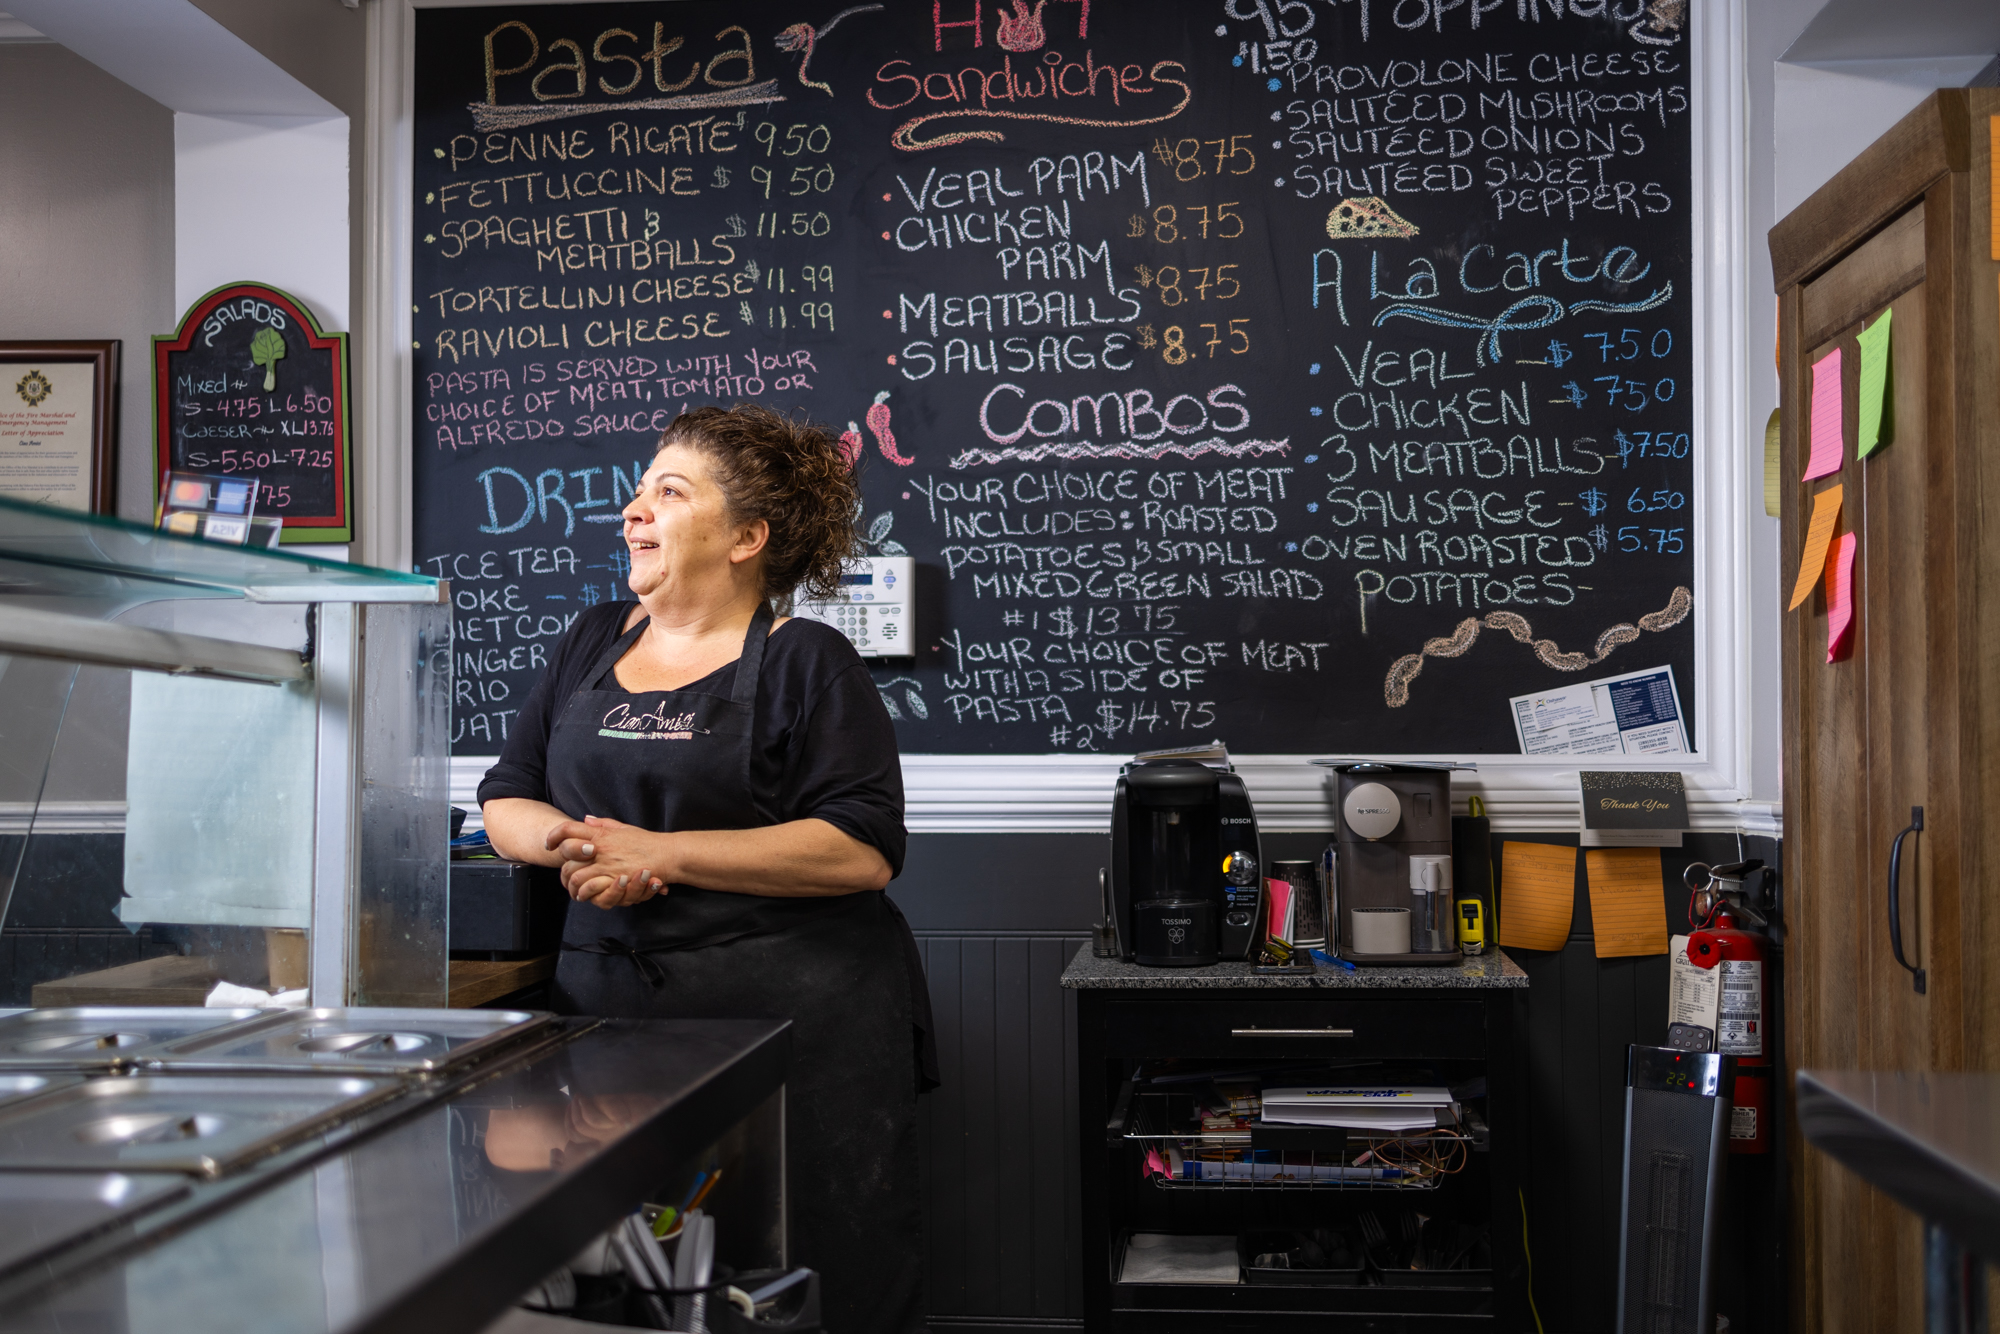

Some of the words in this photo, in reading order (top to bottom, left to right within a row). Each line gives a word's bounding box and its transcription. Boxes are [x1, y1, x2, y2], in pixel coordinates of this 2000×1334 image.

[484, 19, 756, 105] Pasta
[866, 49, 1191, 110] Sandwiches
[1286, 53, 1518, 94] PROVOLONE
[1528, 49, 1680, 83] CHEESE
[1480, 85, 1688, 127] MUSHROOMS
[451, 130, 594, 171] PENNE
[609, 115, 738, 158] RIGATE
[1481, 122, 1646, 157] ONIONS
[440, 167, 701, 213] FETTUCCINE
[897, 167, 1023, 213] VEAL
[1028, 151, 1150, 208] PARM
[1152, 135, 1256, 182] $8.75
[1484, 152, 1614, 188] SWEET
[1493, 182, 1672, 221] PEPPERS
[441, 207, 628, 258] SPAGHETTI
[895, 200, 1072, 252] CHICKEN
[1126, 202, 1244, 244] $8.75
[537, 234, 736, 276] MEATBALLS
[997, 240, 1117, 296] PARM
[429, 284, 626, 319] TORTELLINI
[631, 272, 755, 304] CHEESE
[1133, 263, 1241, 307] $8.75
[1312, 248, 1350, 326] A
[1370, 250, 1440, 300] La
[1458, 237, 1652, 294] Carte
[203, 299, 286, 348] SALADS
[899, 288, 1142, 338] MEATBALLS
[435, 323, 569, 364] RAVIOLI
[584, 311, 731, 349] CHEESE
[901, 332, 1135, 381] SAUSAGE
[1136, 317, 1251, 365] $8.75
[427, 367, 510, 398] PASTA
[523, 363, 546, 384] IS
[557, 355, 658, 382] SERVED
[666, 353, 731, 377] WITH
[1334, 340, 1476, 389] VEAL
[427, 394, 517, 423] CHOICE
[524, 390, 560, 413] OF
[656, 376, 766, 399] TOMATO
[774, 373, 813, 391] OR
[1333, 381, 1531, 438] CHICKEN
[437, 418, 565, 450] ALFREDO
[1320, 433, 1356, 483] 3
[1368, 433, 1604, 483] MEATBALLS
[475, 460, 654, 538] DRIN
[908, 474, 1008, 523] YOUR
[1012, 470, 1140, 504] CHOICE
[1147, 471, 1187, 501] OF
[1193, 467, 1295, 503] MEAT
[1326, 486, 1562, 529] SAUSAGE
[1139, 499, 1278, 537] ROASTED
[427, 551, 503, 581] ICE
[509, 546, 581, 577] TEA
[941, 541, 1127, 580] POTATOES
[1156, 540, 1265, 568] SMALL
[1301, 534, 1407, 562] OVEN
[1416, 530, 1595, 568] ROASTED
[448, 584, 529, 613] OKE
[972, 571, 1081, 599] MIXED
[1086, 571, 1211, 600] GREEN
[1220, 568, 1323, 600] SALAD
[1355, 568, 1575, 637] POTATOES
[515, 611, 579, 639] COK
[940, 629, 1035, 674] YOUR
[1043, 638, 1175, 667] CHOICE
[1181, 640, 1229, 666] OF
[1241, 640, 1329, 671] MEAT
[944, 668, 1020, 696] WITH
[1024, 668, 1049, 691] A
[1059, 667, 1149, 693] SIDE
[1158, 668, 1207, 691] OF
[944, 693, 1073, 724] PASTA
[1600, 797, 1640, 811] Thank
[1641, 798, 1671, 813] You
[1666, 1071, 1687, 1086] 22
